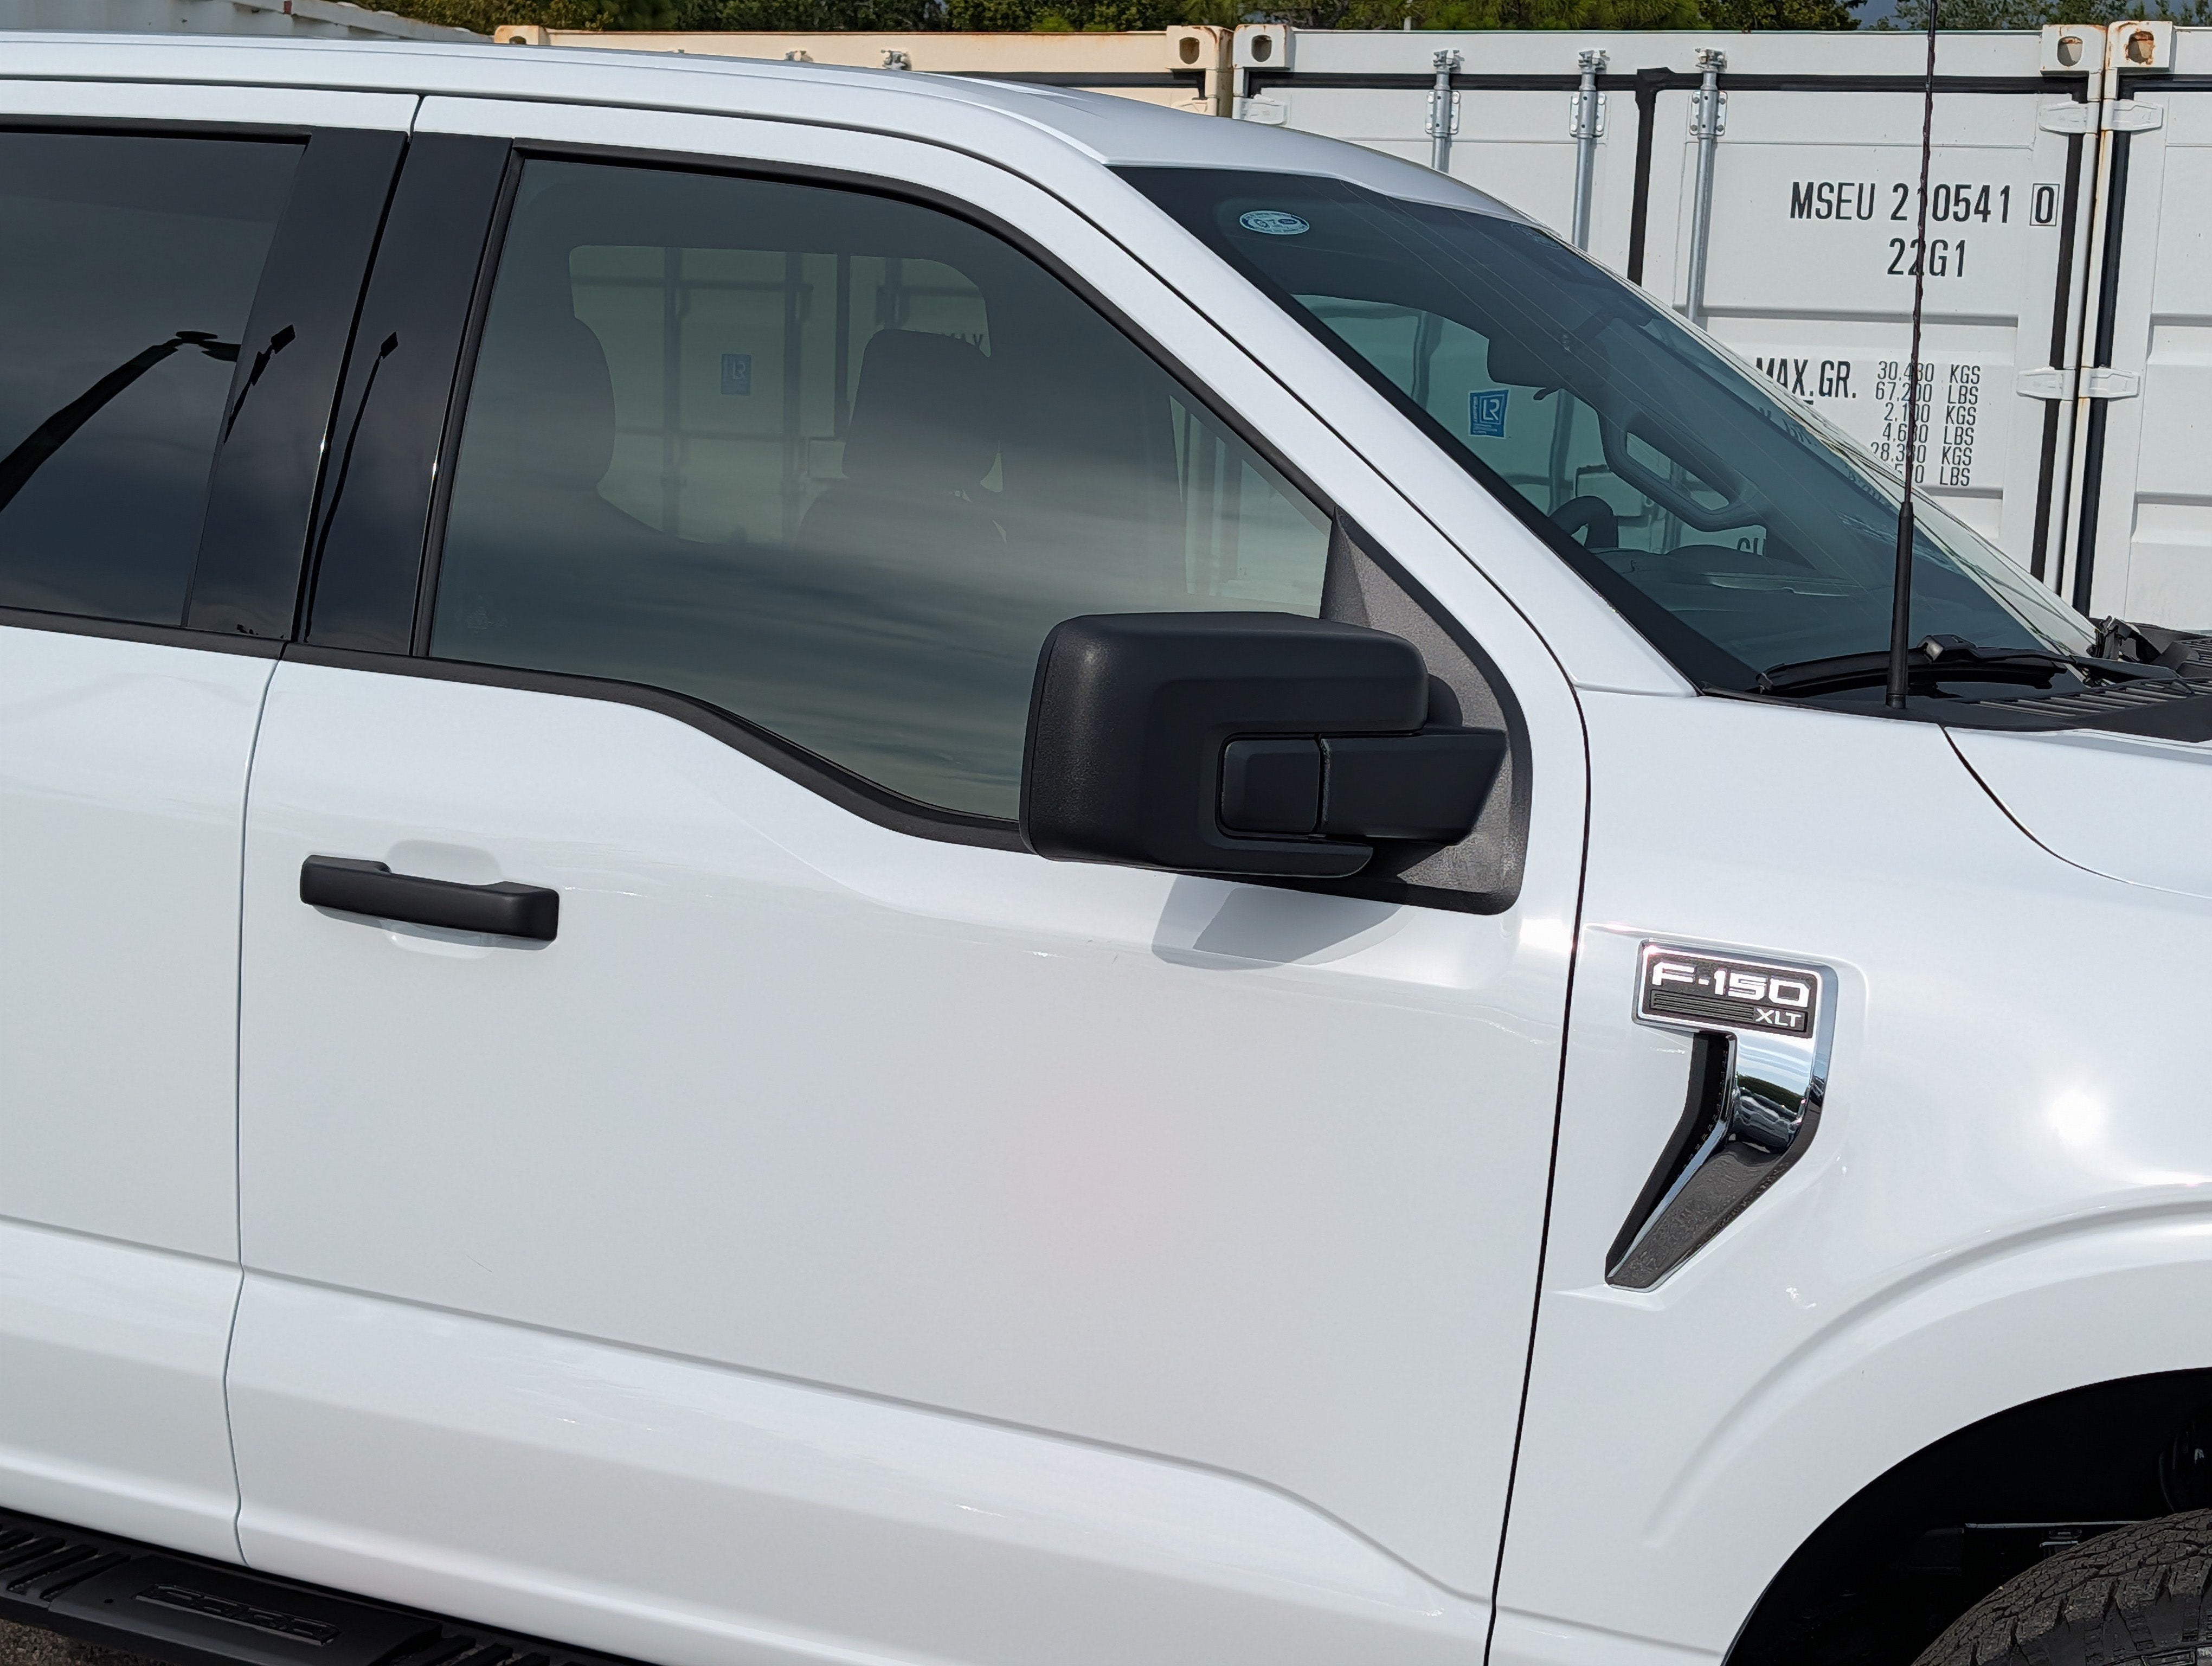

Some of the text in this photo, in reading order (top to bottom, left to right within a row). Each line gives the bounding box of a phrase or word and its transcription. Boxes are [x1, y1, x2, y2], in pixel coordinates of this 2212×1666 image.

[1790, 182, 2055, 224] MSEU 20541 0
[1887, 238, 1966, 278] 22G1
[1949, 364, 1981, 385] KGS
[1947, 385, 1979, 405] LBS
[1945, 405, 1977, 426] KGS
[1944, 426, 1975, 446] LBS
[1941, 446, 1973, 466] KGS
[1939, 466, 1971, 487] LBS
[1651, 961, 1811, 1008] F-150
[1755, 1007, 1803, 1028] XLT
